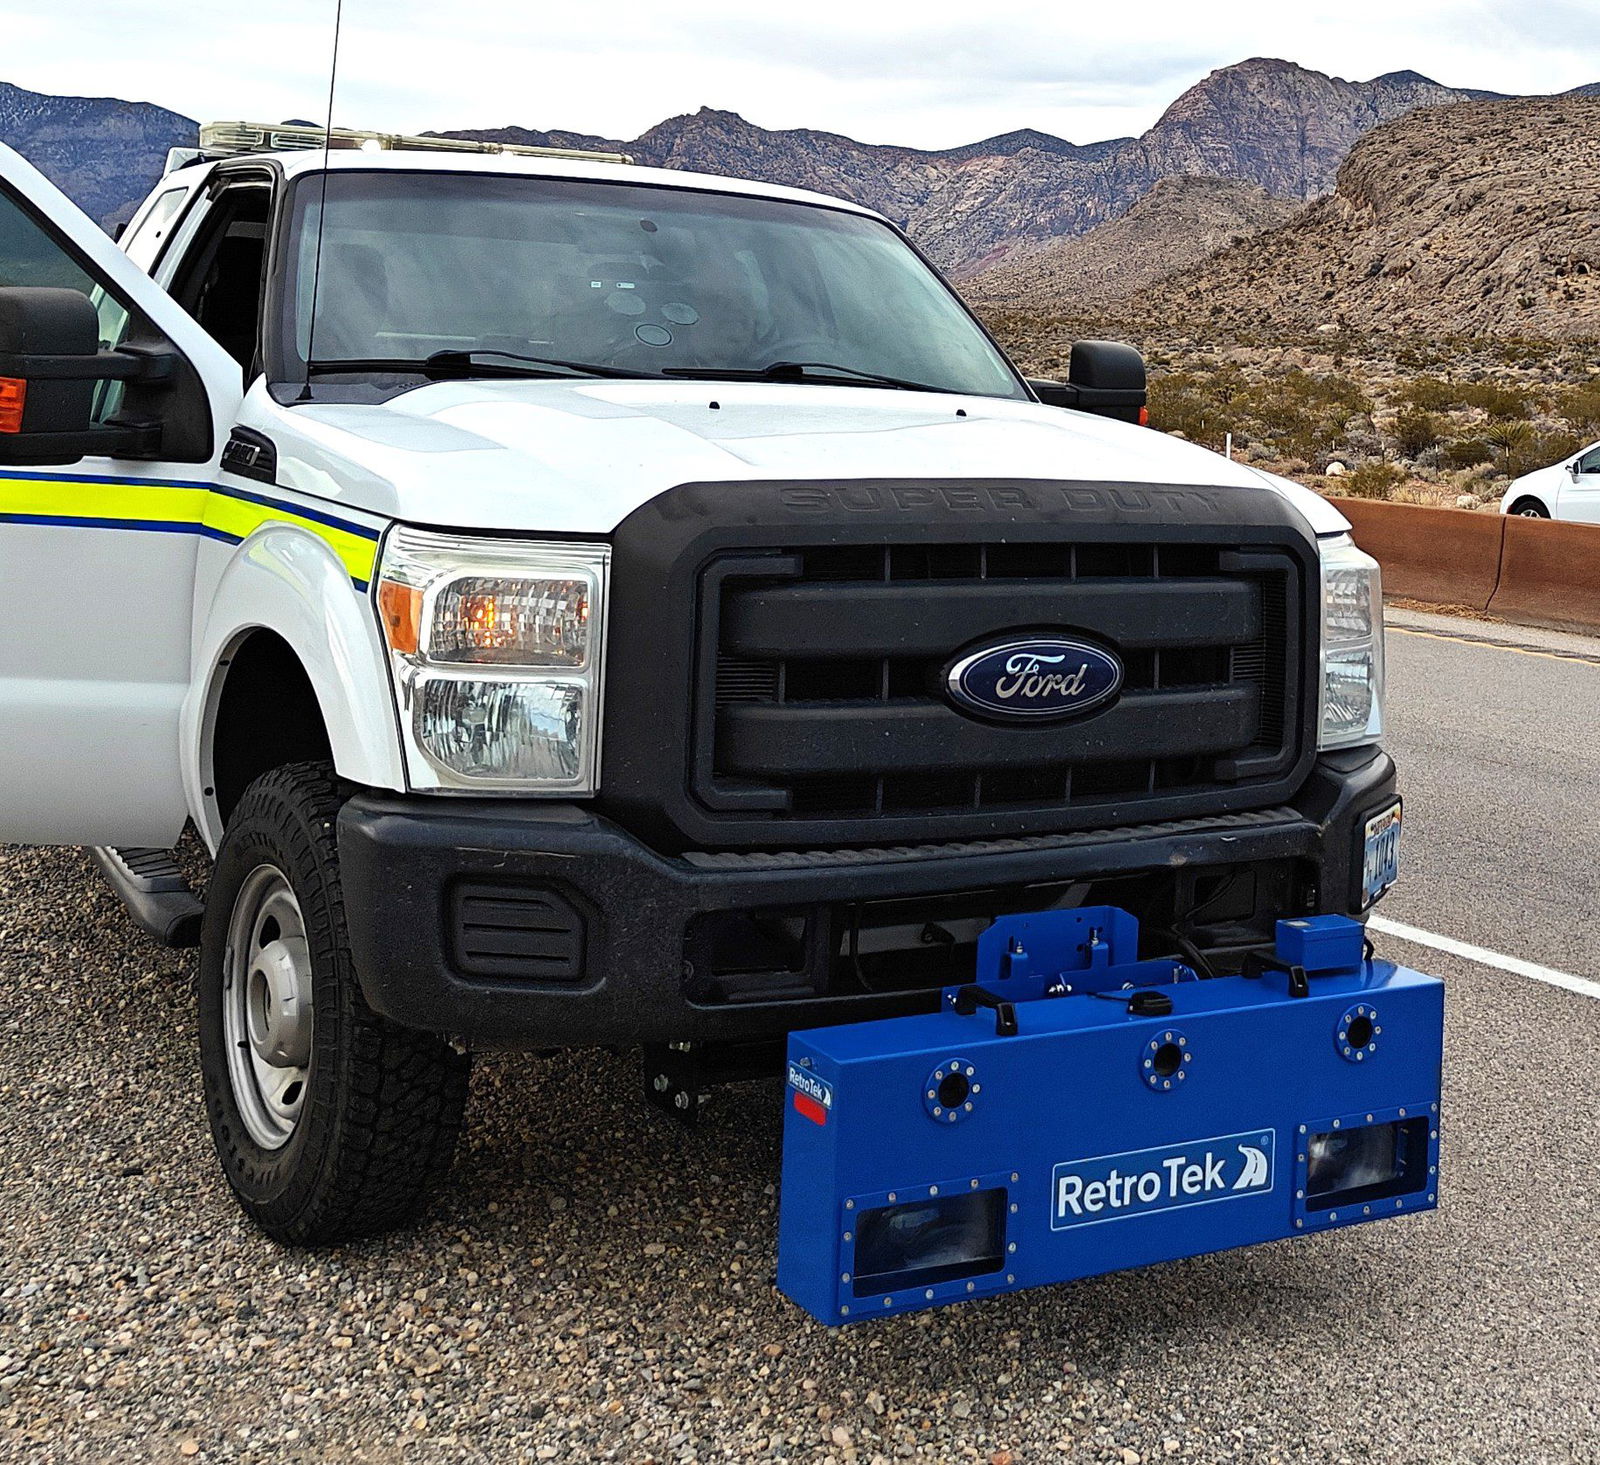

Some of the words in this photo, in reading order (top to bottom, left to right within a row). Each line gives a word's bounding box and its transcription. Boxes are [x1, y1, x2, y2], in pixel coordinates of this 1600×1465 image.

[779, 486, 1036, 513] SUPER
[1061, 486, 1223, 513] DUTY
[995, 653, 1088, 699] Ford
[789, 1066, 822, 1100] RetroTek
[1057, 1151, 1226, 1218] RetroTek
